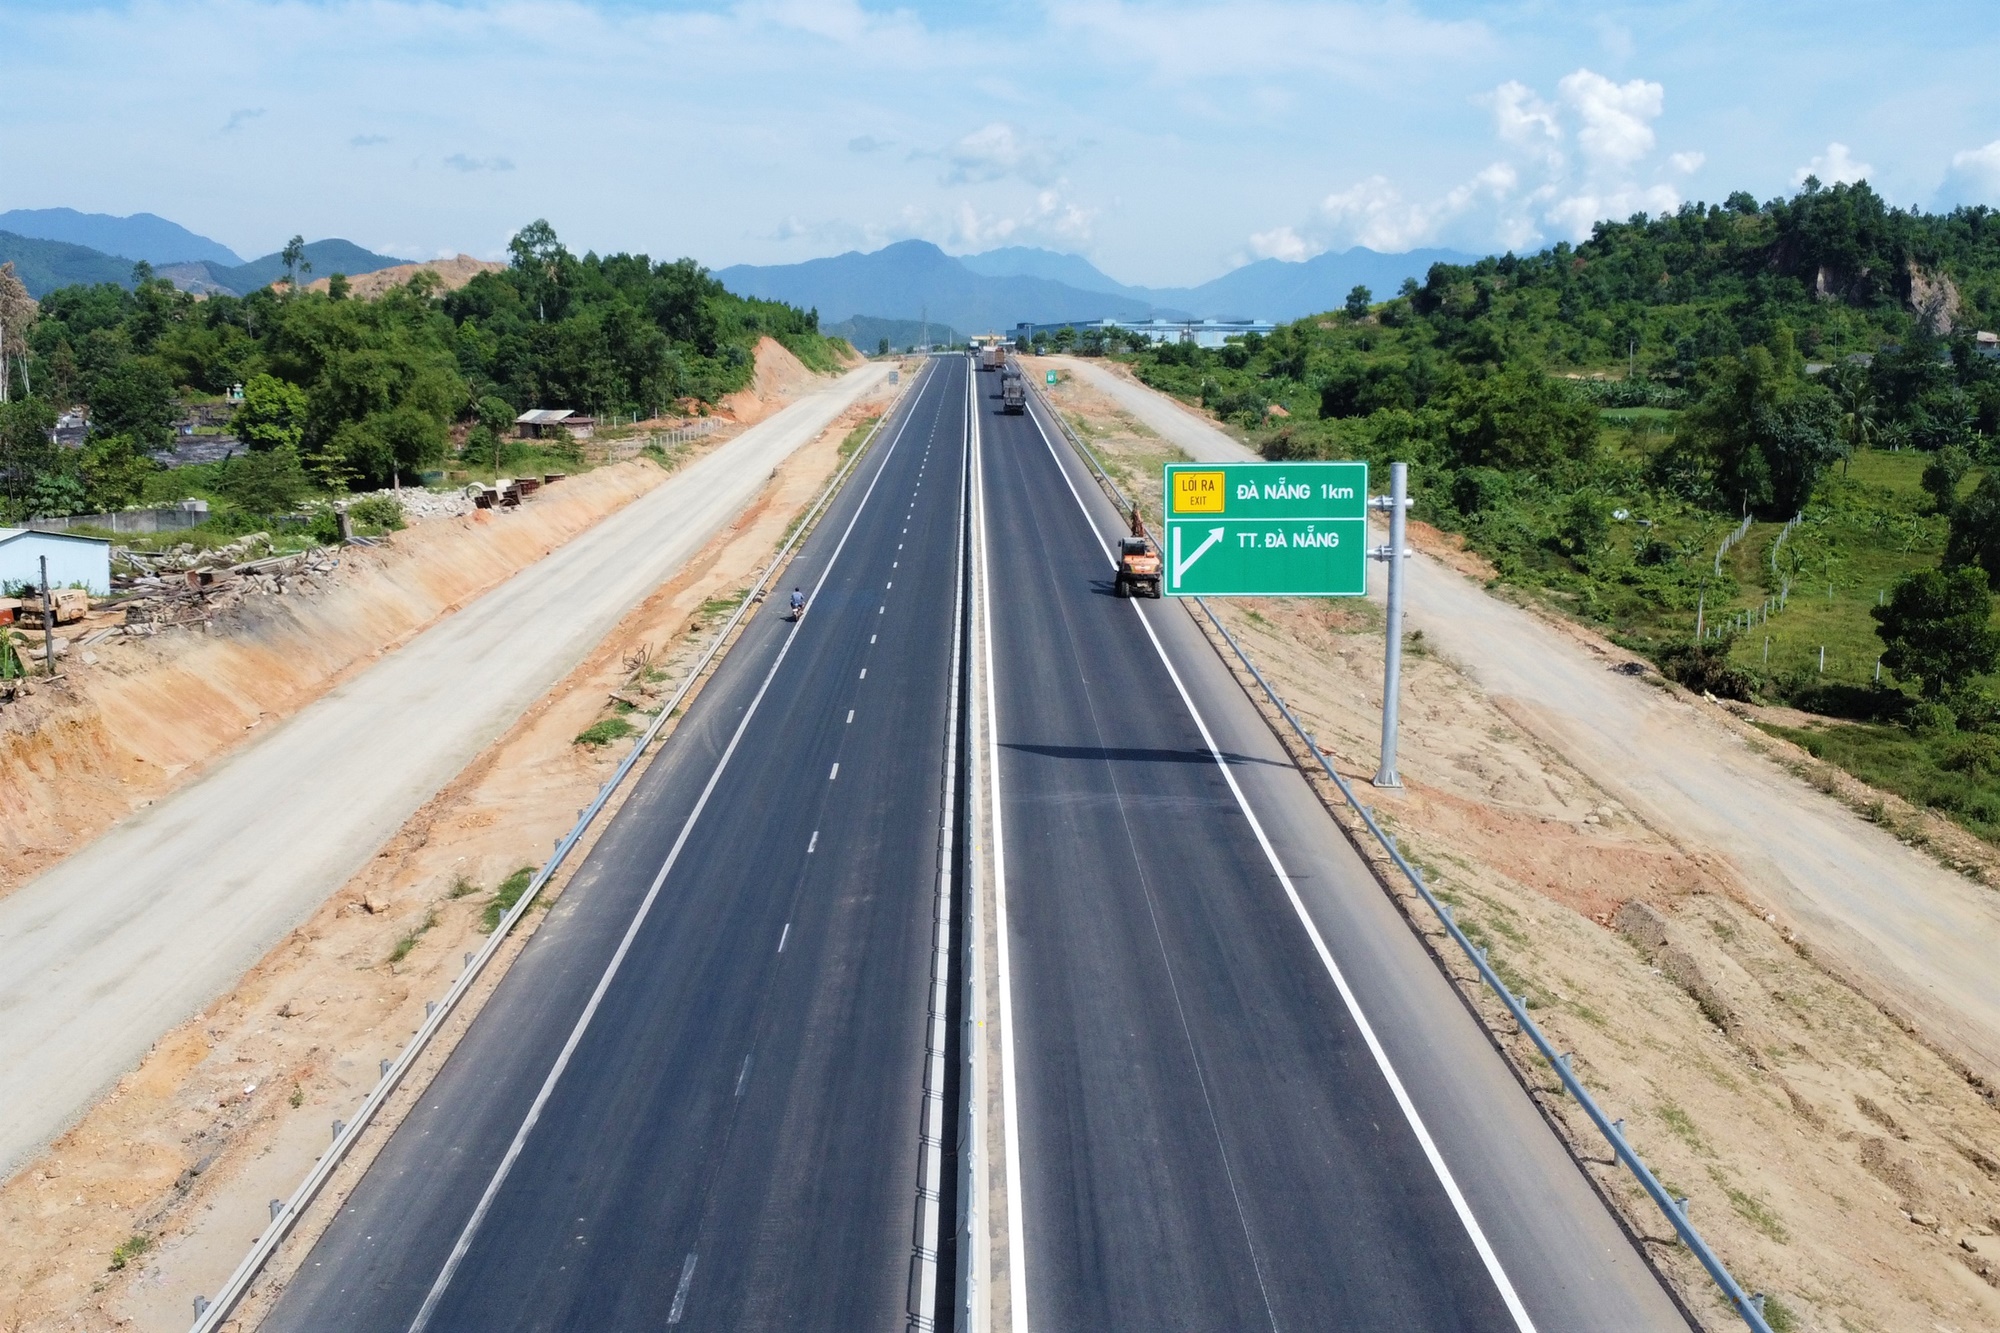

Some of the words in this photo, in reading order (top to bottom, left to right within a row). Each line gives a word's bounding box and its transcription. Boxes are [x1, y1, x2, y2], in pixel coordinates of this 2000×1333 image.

[1182, 474, 1197, 491] LỐI
[1201, 479, 1215, 491] RA
[1237, 480, 1259, 499] ĐÀ
[1265, 477, 1310, 499] NẴNG
[1320, 484, 1353, 499] 1km
[1190, 496, 1207, 506] EXIT
[1237, 533, 1262, 548] TT.
[1265, 529, 1288, 548] ĐÀ
[1293, 525, 1339, 548] NẴNG
